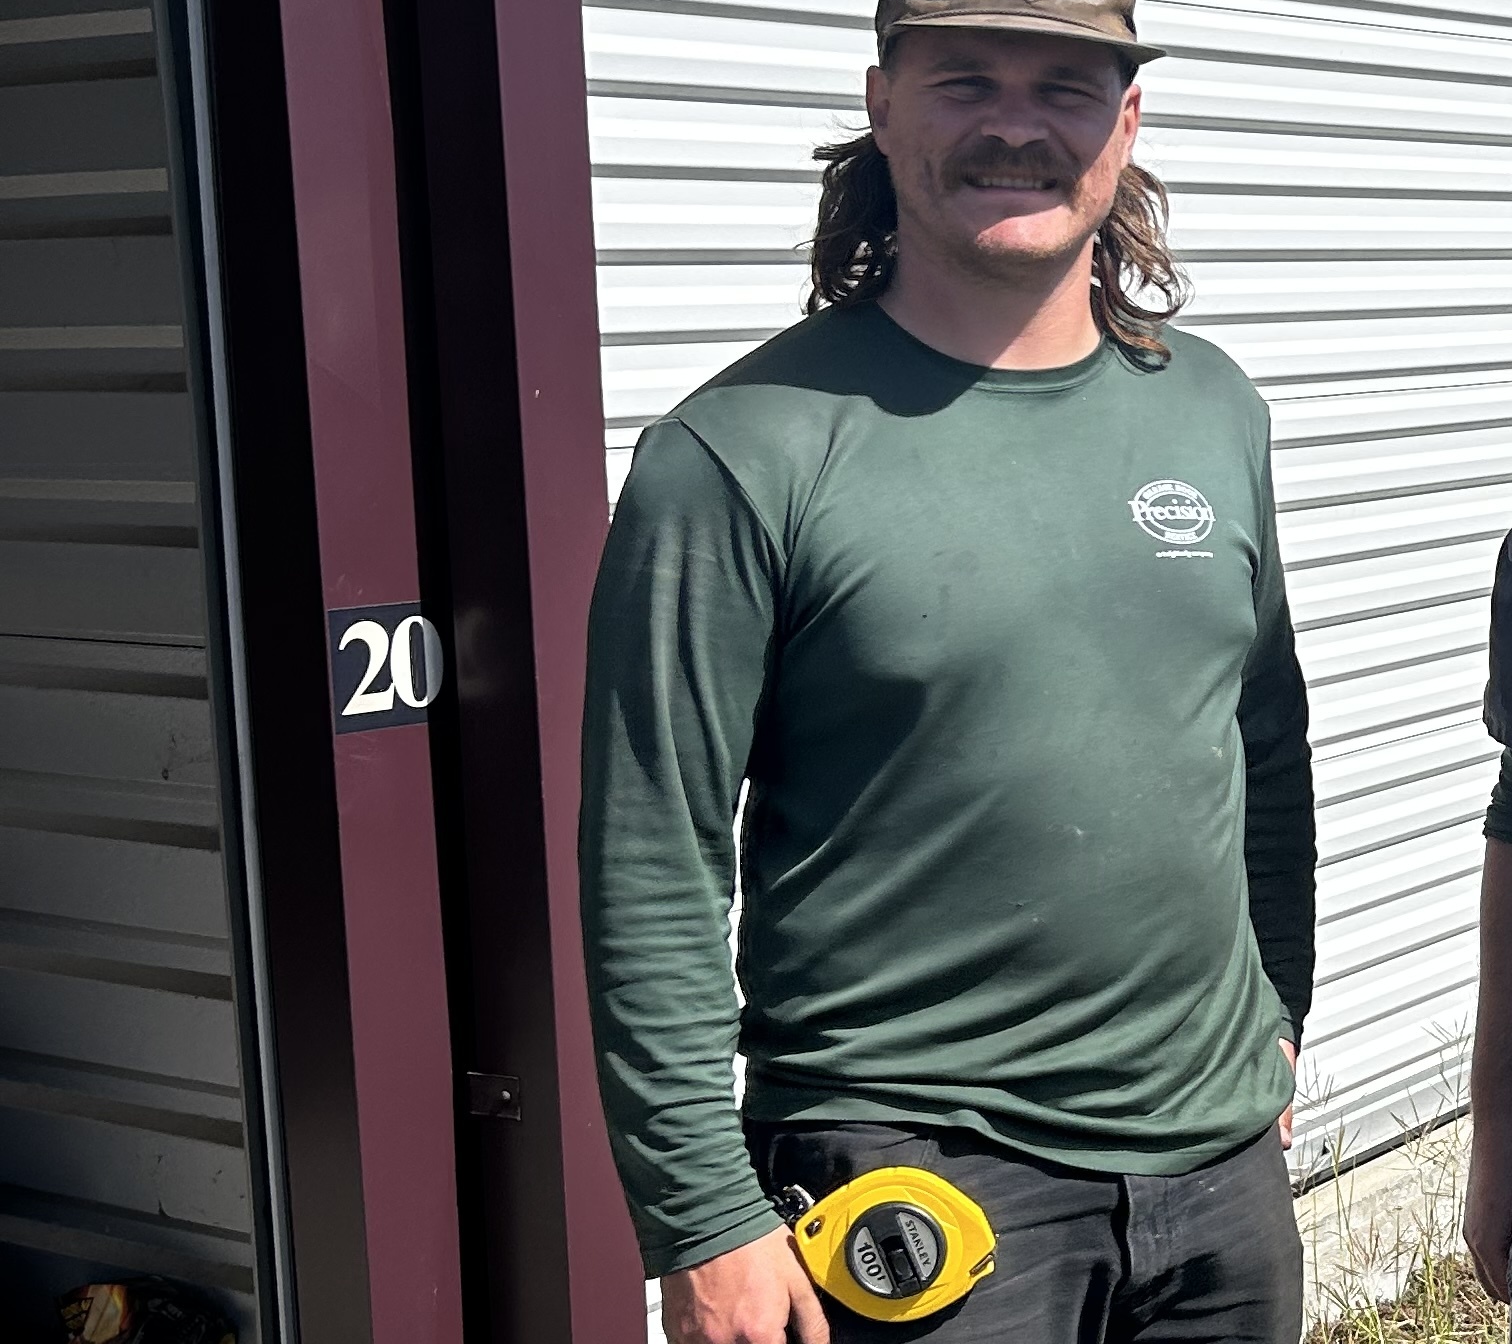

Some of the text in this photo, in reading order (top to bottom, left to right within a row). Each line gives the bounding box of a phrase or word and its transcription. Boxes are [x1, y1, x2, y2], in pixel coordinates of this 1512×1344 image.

[1128, 498, 1217, 522] Precision
[338, 615, 444, 716] 20
[857, 1241, 888, 1282] 100'
[905, 1219, 931, 1267] STANLEY
